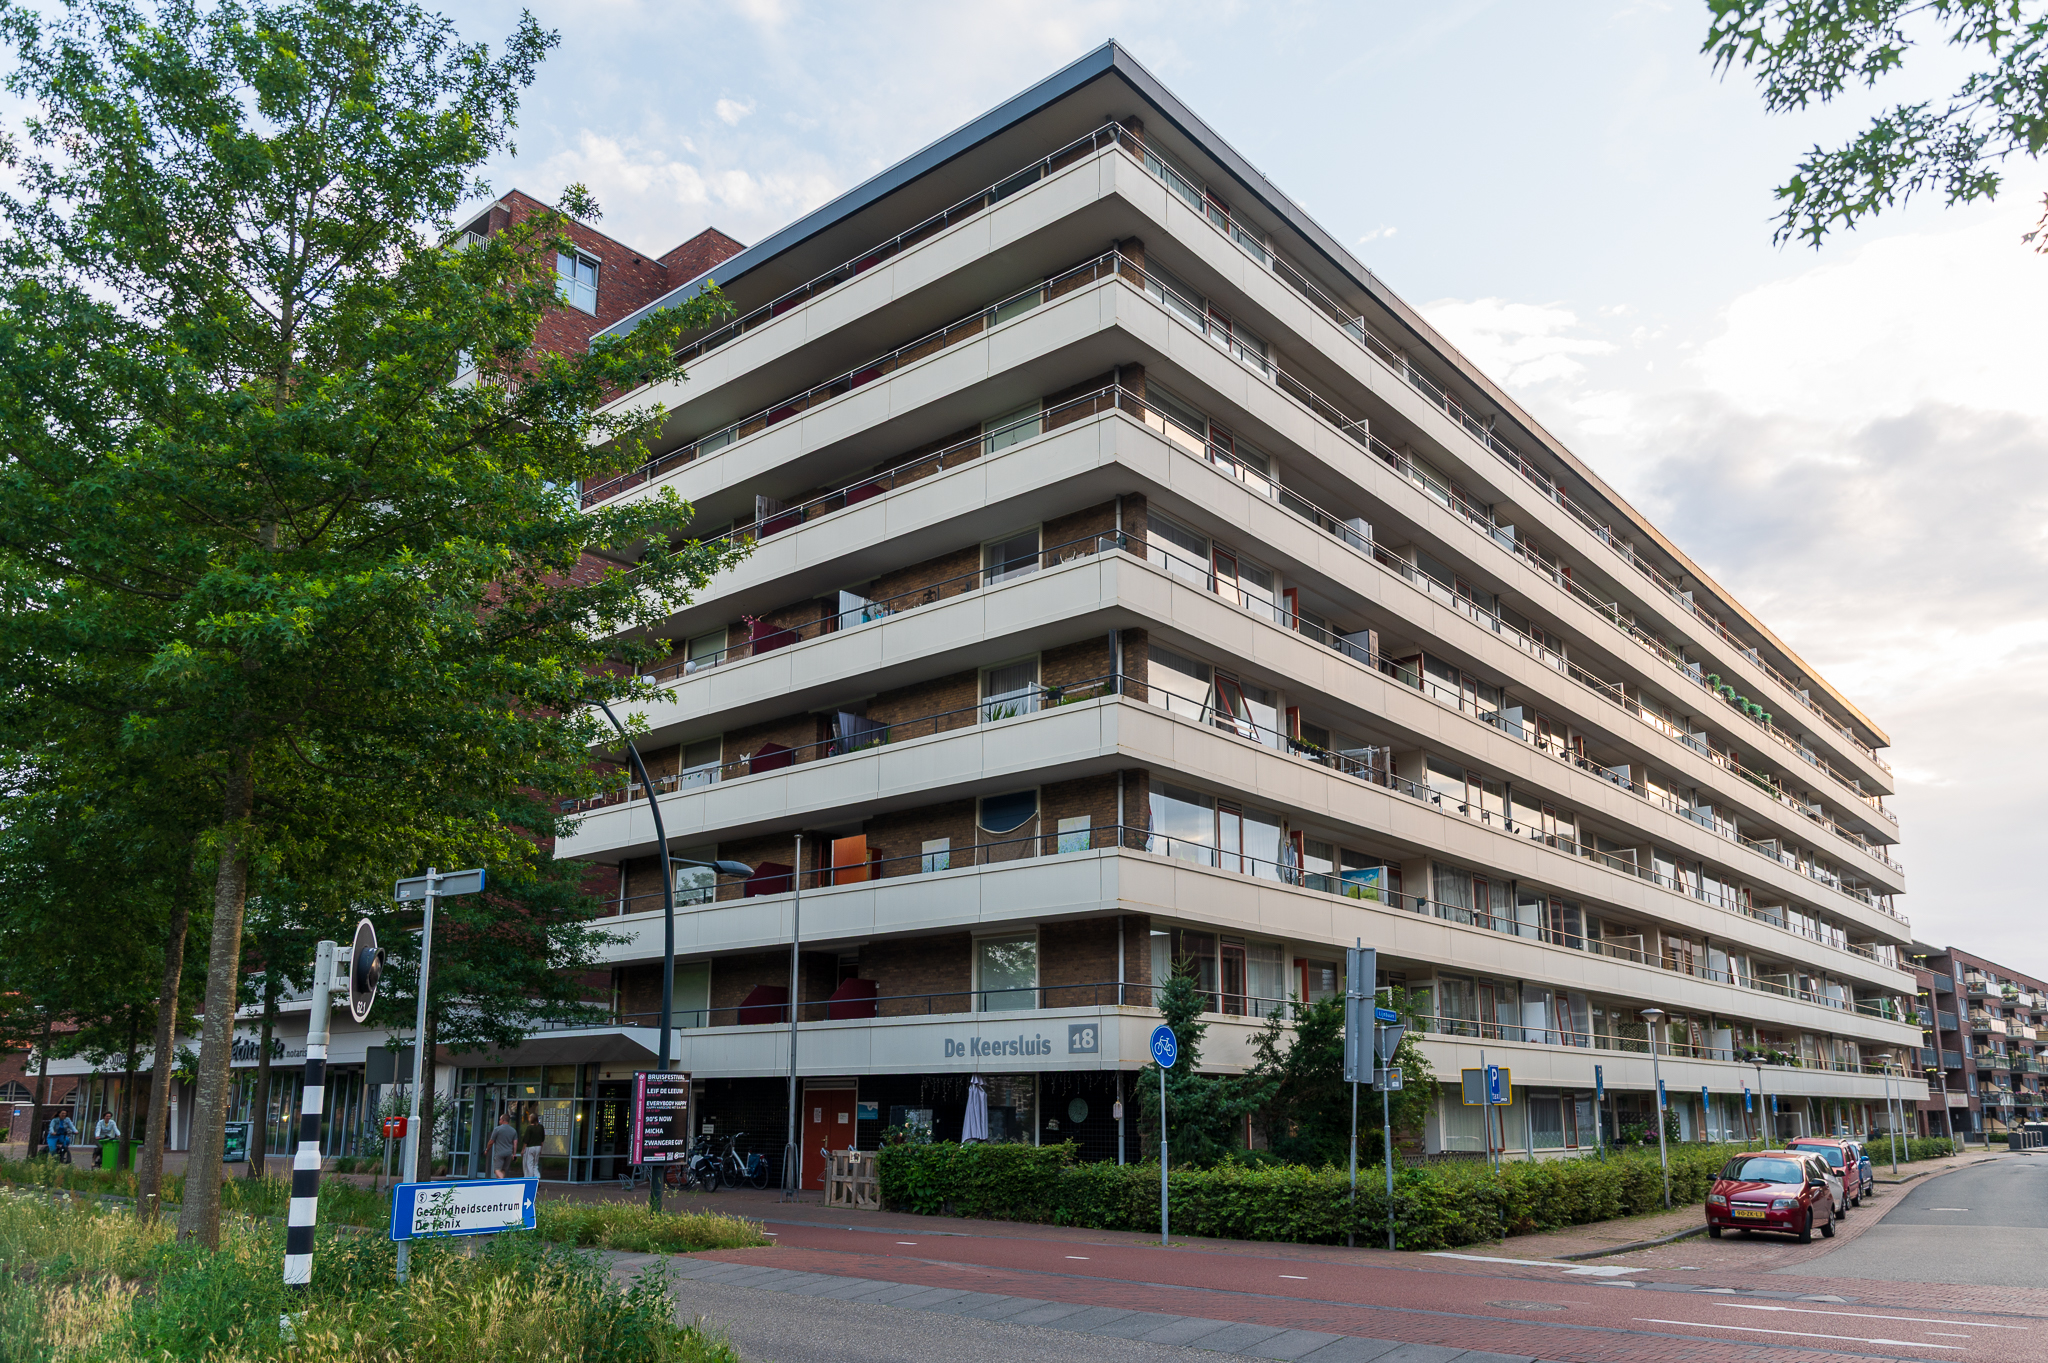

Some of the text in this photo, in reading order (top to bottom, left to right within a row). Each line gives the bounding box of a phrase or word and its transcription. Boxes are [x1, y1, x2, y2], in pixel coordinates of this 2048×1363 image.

[944, 1033, 1051, 1058] De Keersluis
[1072, 1028, 1094, 1049] 18
[1492, 1068, 1498, 1087] P
[416, 1202, 520, 1217] Gezondheidscentrum
